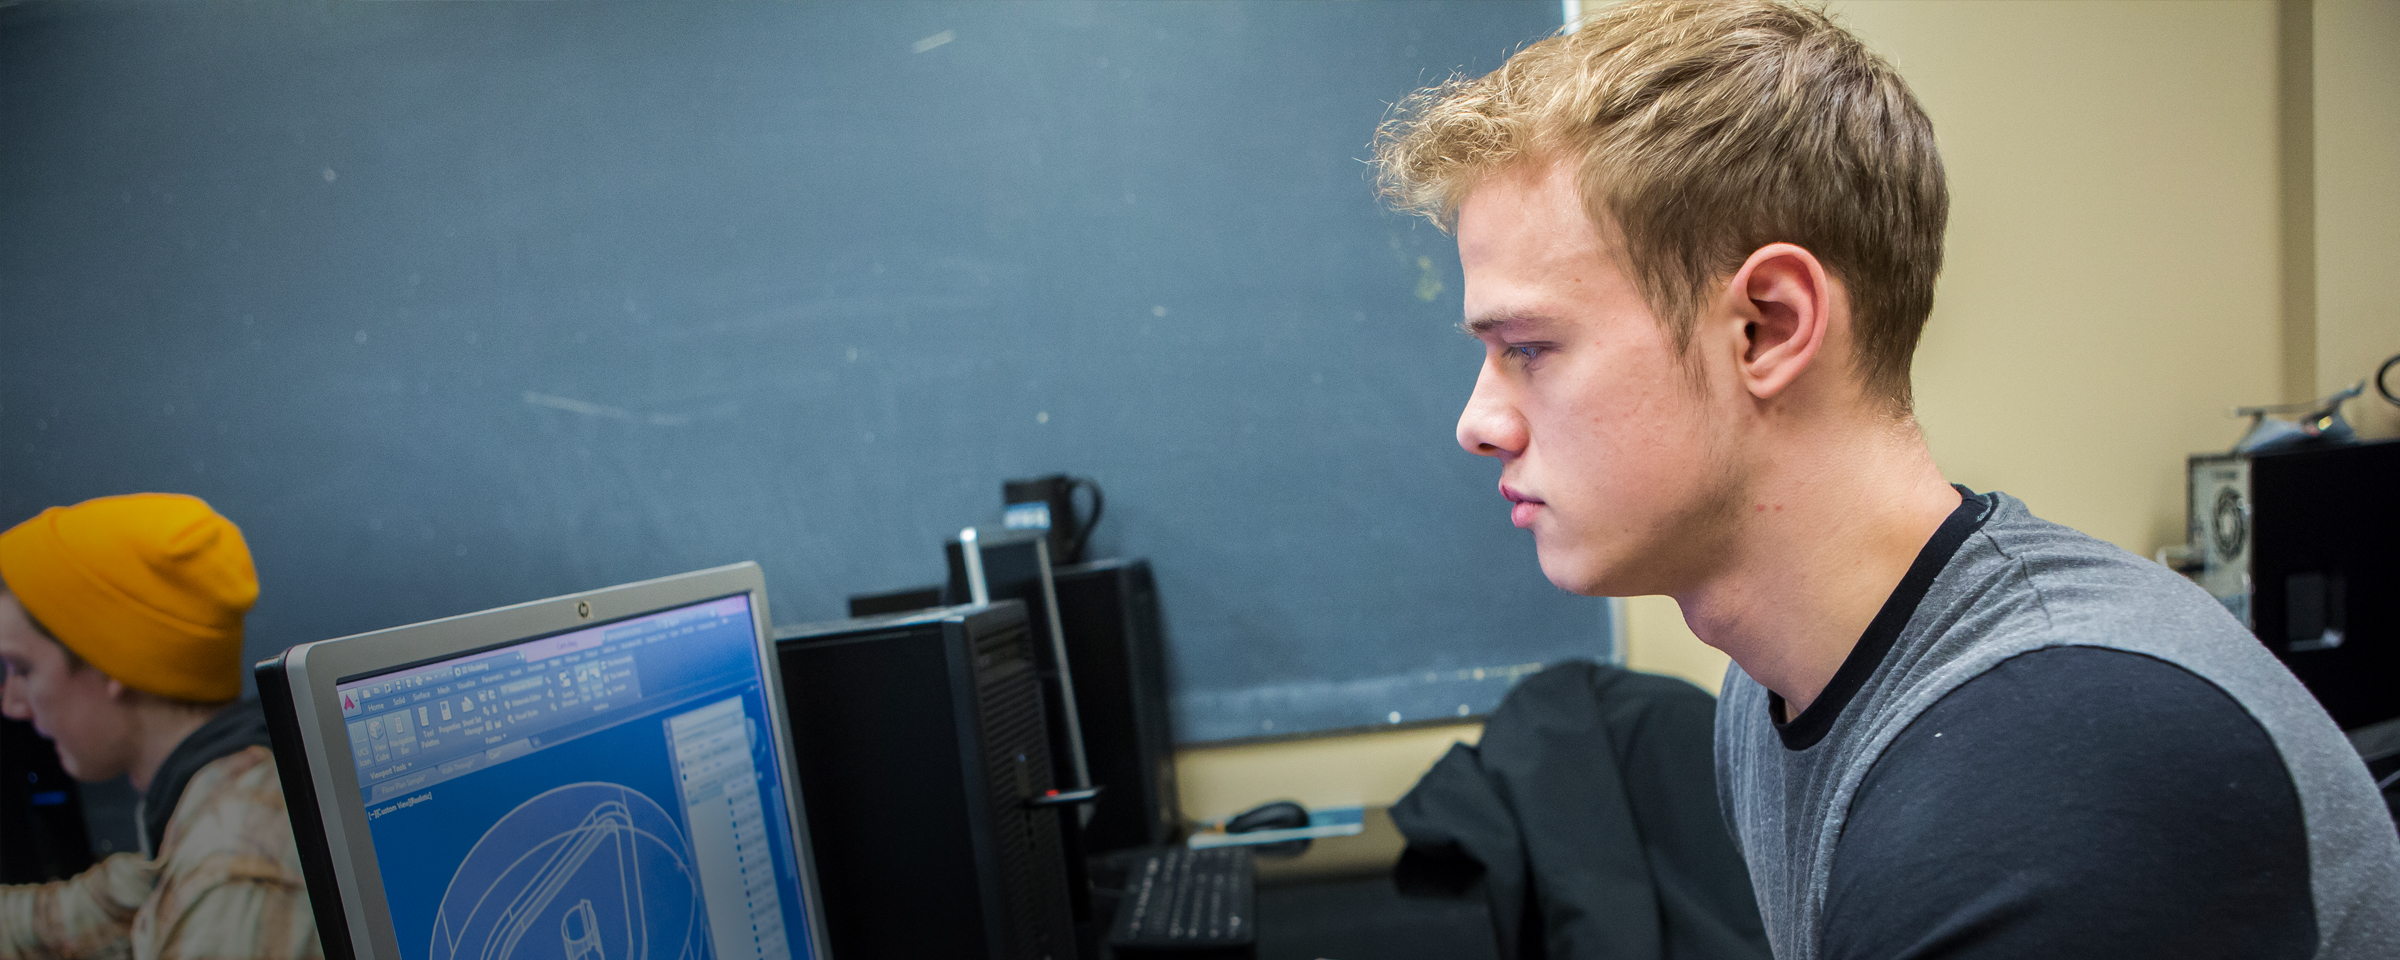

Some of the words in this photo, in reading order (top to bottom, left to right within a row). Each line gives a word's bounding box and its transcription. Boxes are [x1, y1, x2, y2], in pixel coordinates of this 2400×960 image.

[367, 703, 385, 712] Home
[393, 696, 406, 706] Solid
[412, 691, 431, 701] Surface
[437, 685, 451, 694] Mesh
[438, 722, 461, 734] Properties
[422, 729, 435, 738] Tool
[389, 736, 417, 748] Navigation
[421, 738, 440, 749] Palettes
[357, 748, 370, 757] UCS
[374, 743, 387, 752] View
[400, 746, 410, 755] Bar
[359, 758, 371, 767] Icon
[375, 753, 390, 763] Cube
[370, 766, 393, 780] Viewport
[392, 763, 407, 773] Tools
[381, 784, 395, 794] Floor
[395, 781, 407, 791] Plan
